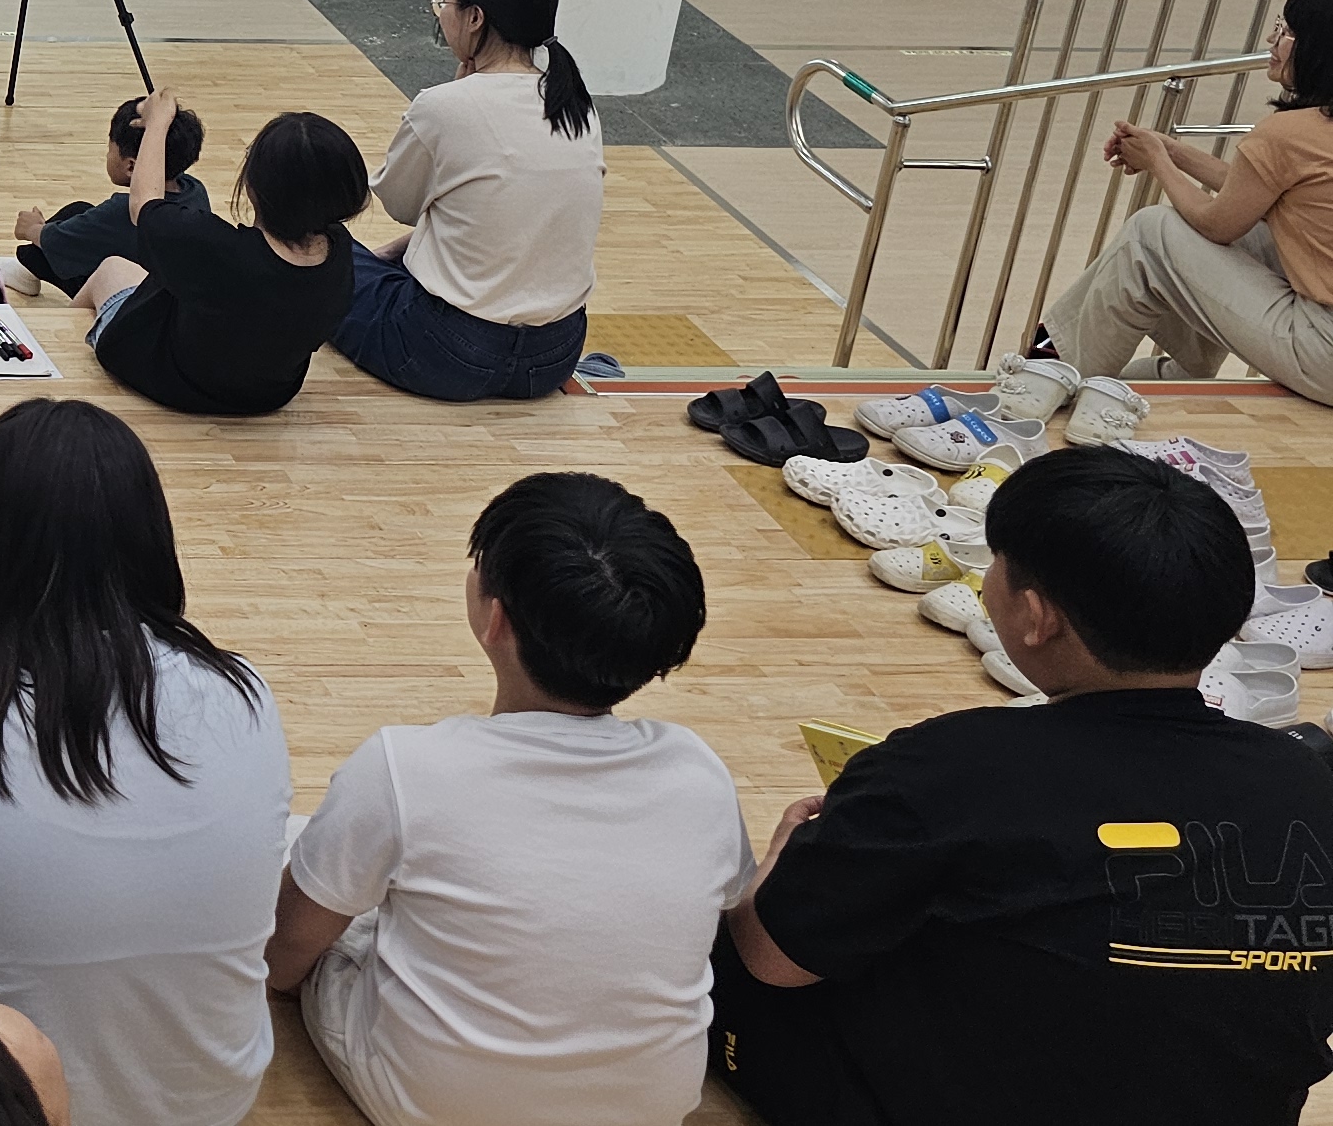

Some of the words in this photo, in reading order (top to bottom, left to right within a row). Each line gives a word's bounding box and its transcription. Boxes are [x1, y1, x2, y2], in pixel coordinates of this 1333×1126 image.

[1097, 820, 1333, 908] FILA
[1109, 907, 1333, 947] HERITAG
[725, 1031, 738, 1071] FILA
